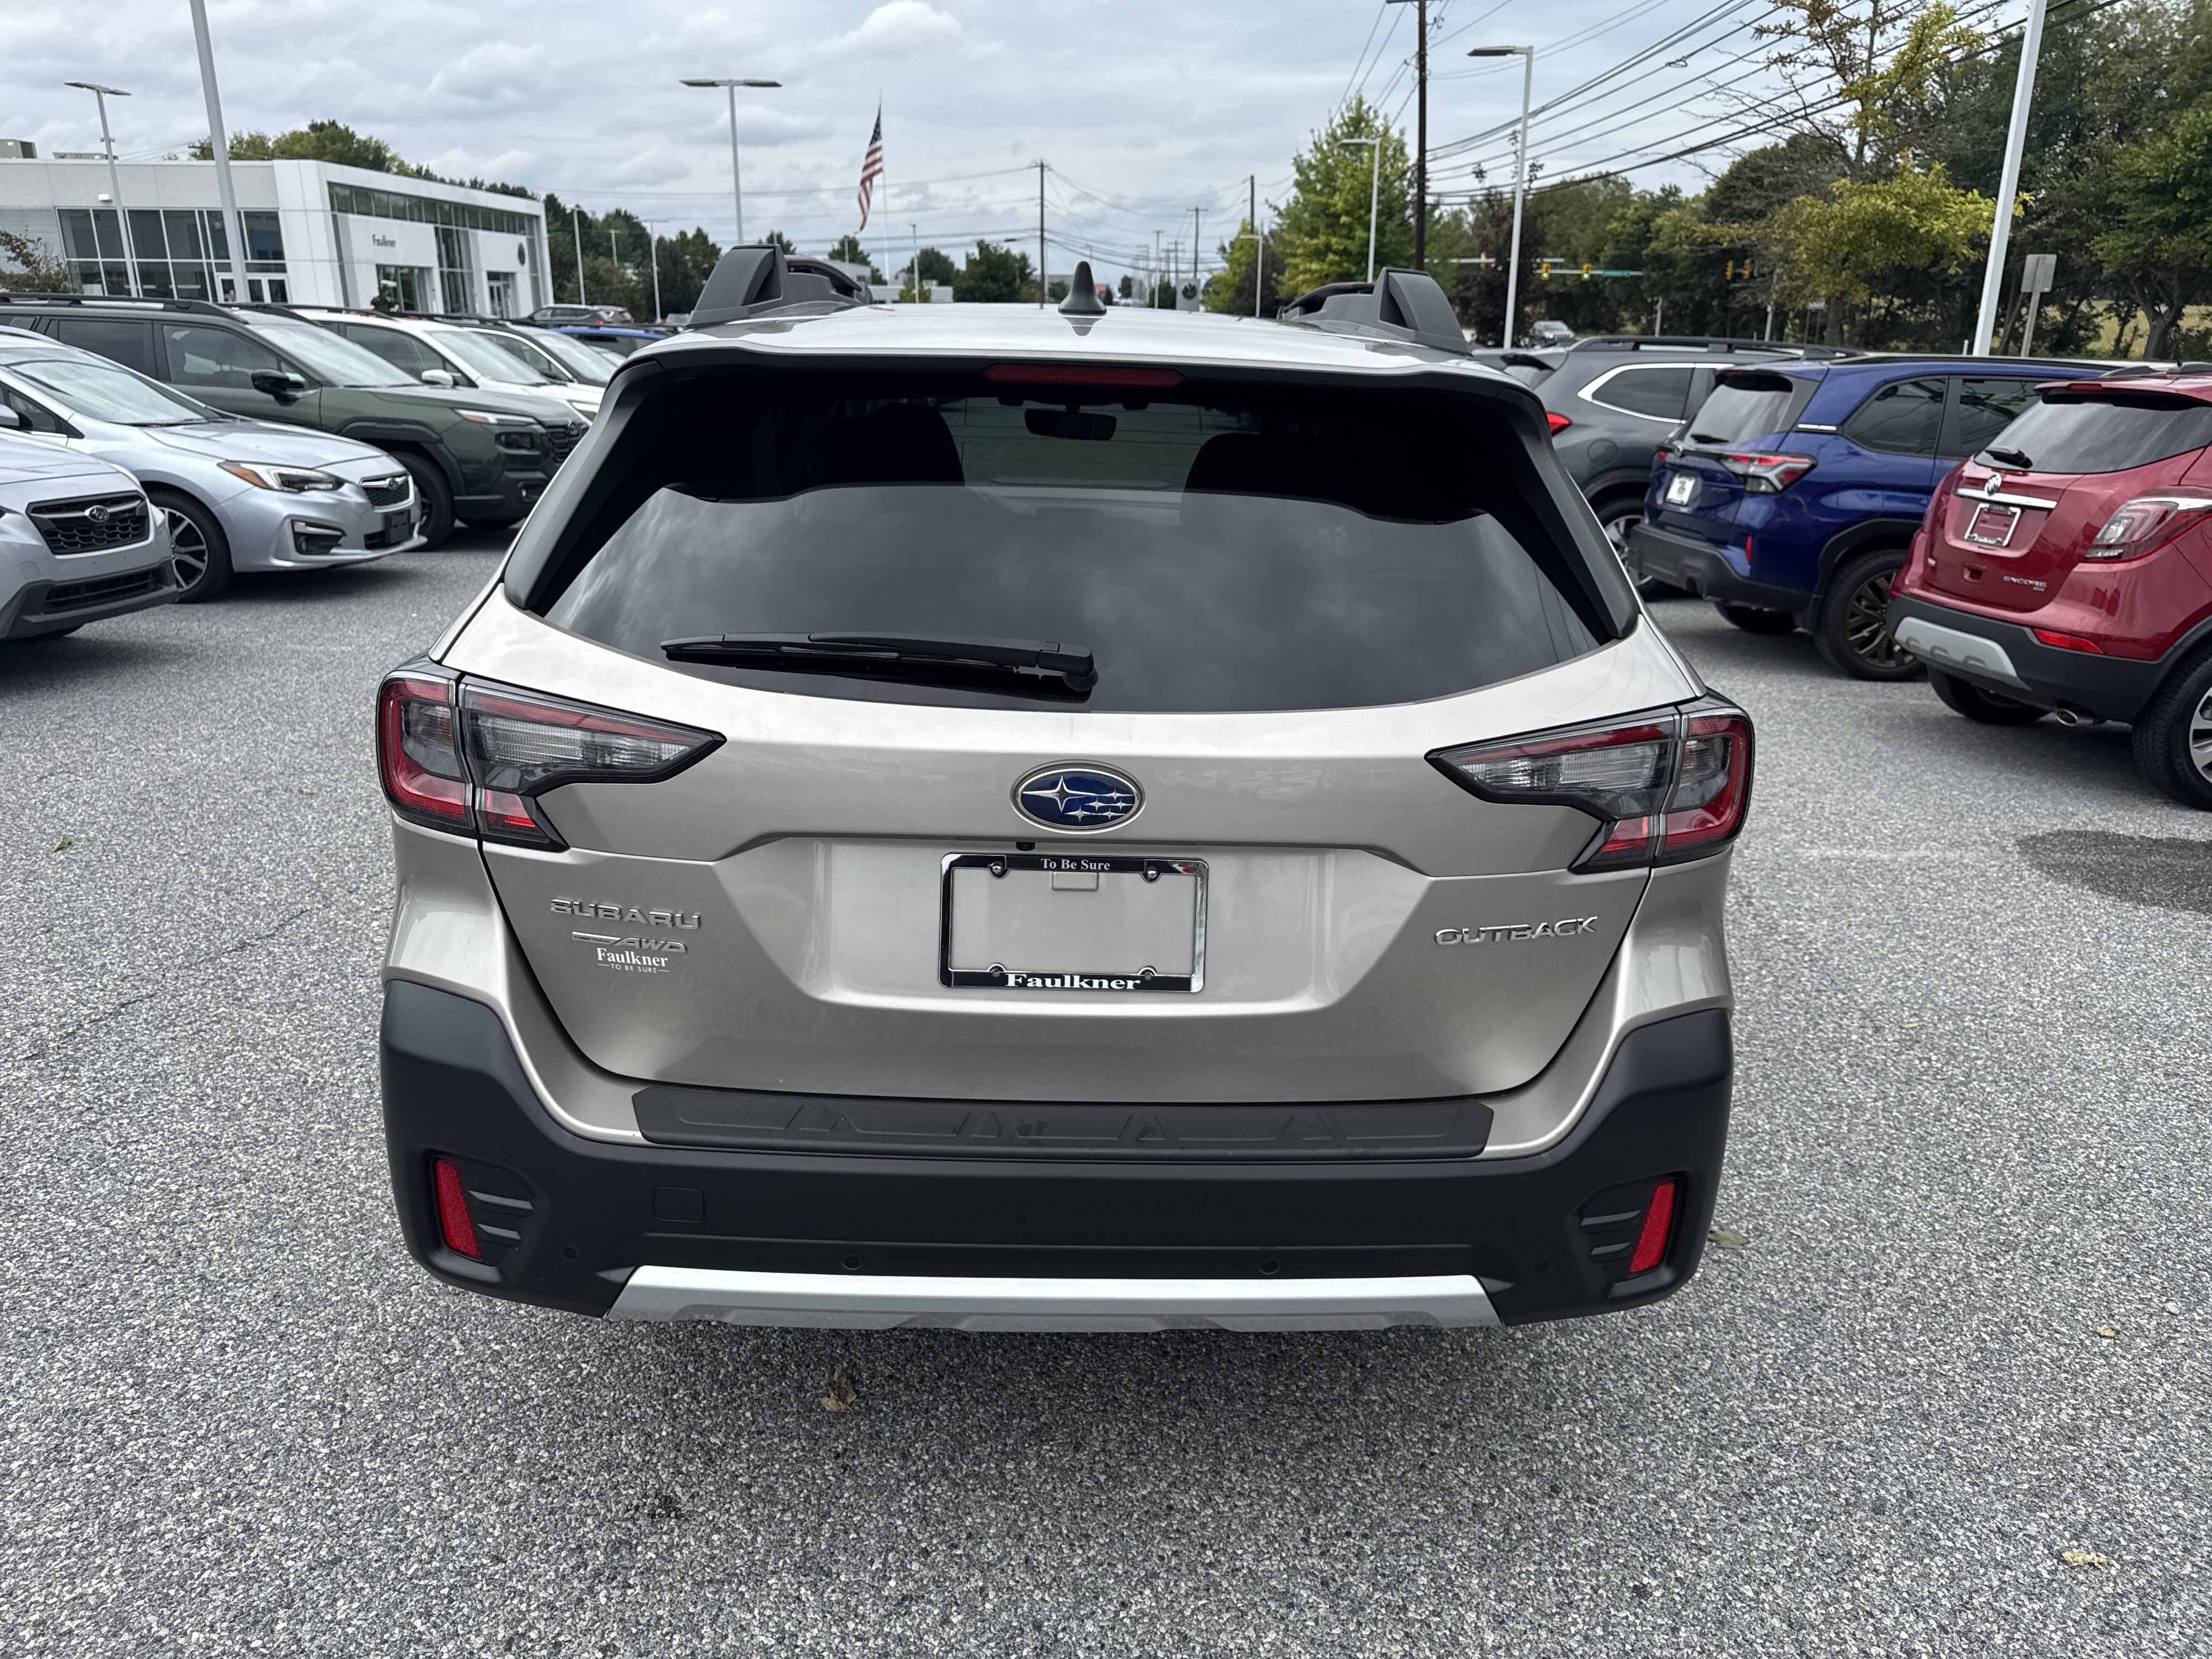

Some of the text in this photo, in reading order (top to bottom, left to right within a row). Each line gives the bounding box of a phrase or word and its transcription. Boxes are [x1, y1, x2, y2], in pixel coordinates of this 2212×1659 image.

[372, 234, 396, 247] Faulkner
[2003, 575, 2047, 588] ENCORE
[1041, 859, 1110, 870] To Be Sure
[550, 898, 702, 930] SUBARU
[1434, 916, 1598, 945] OUTBACK
[614, 937, 688, 953] AWD
[596, 947, 668, 967] Faulkner
[1005, 974, 1141, 990] Faulkner
